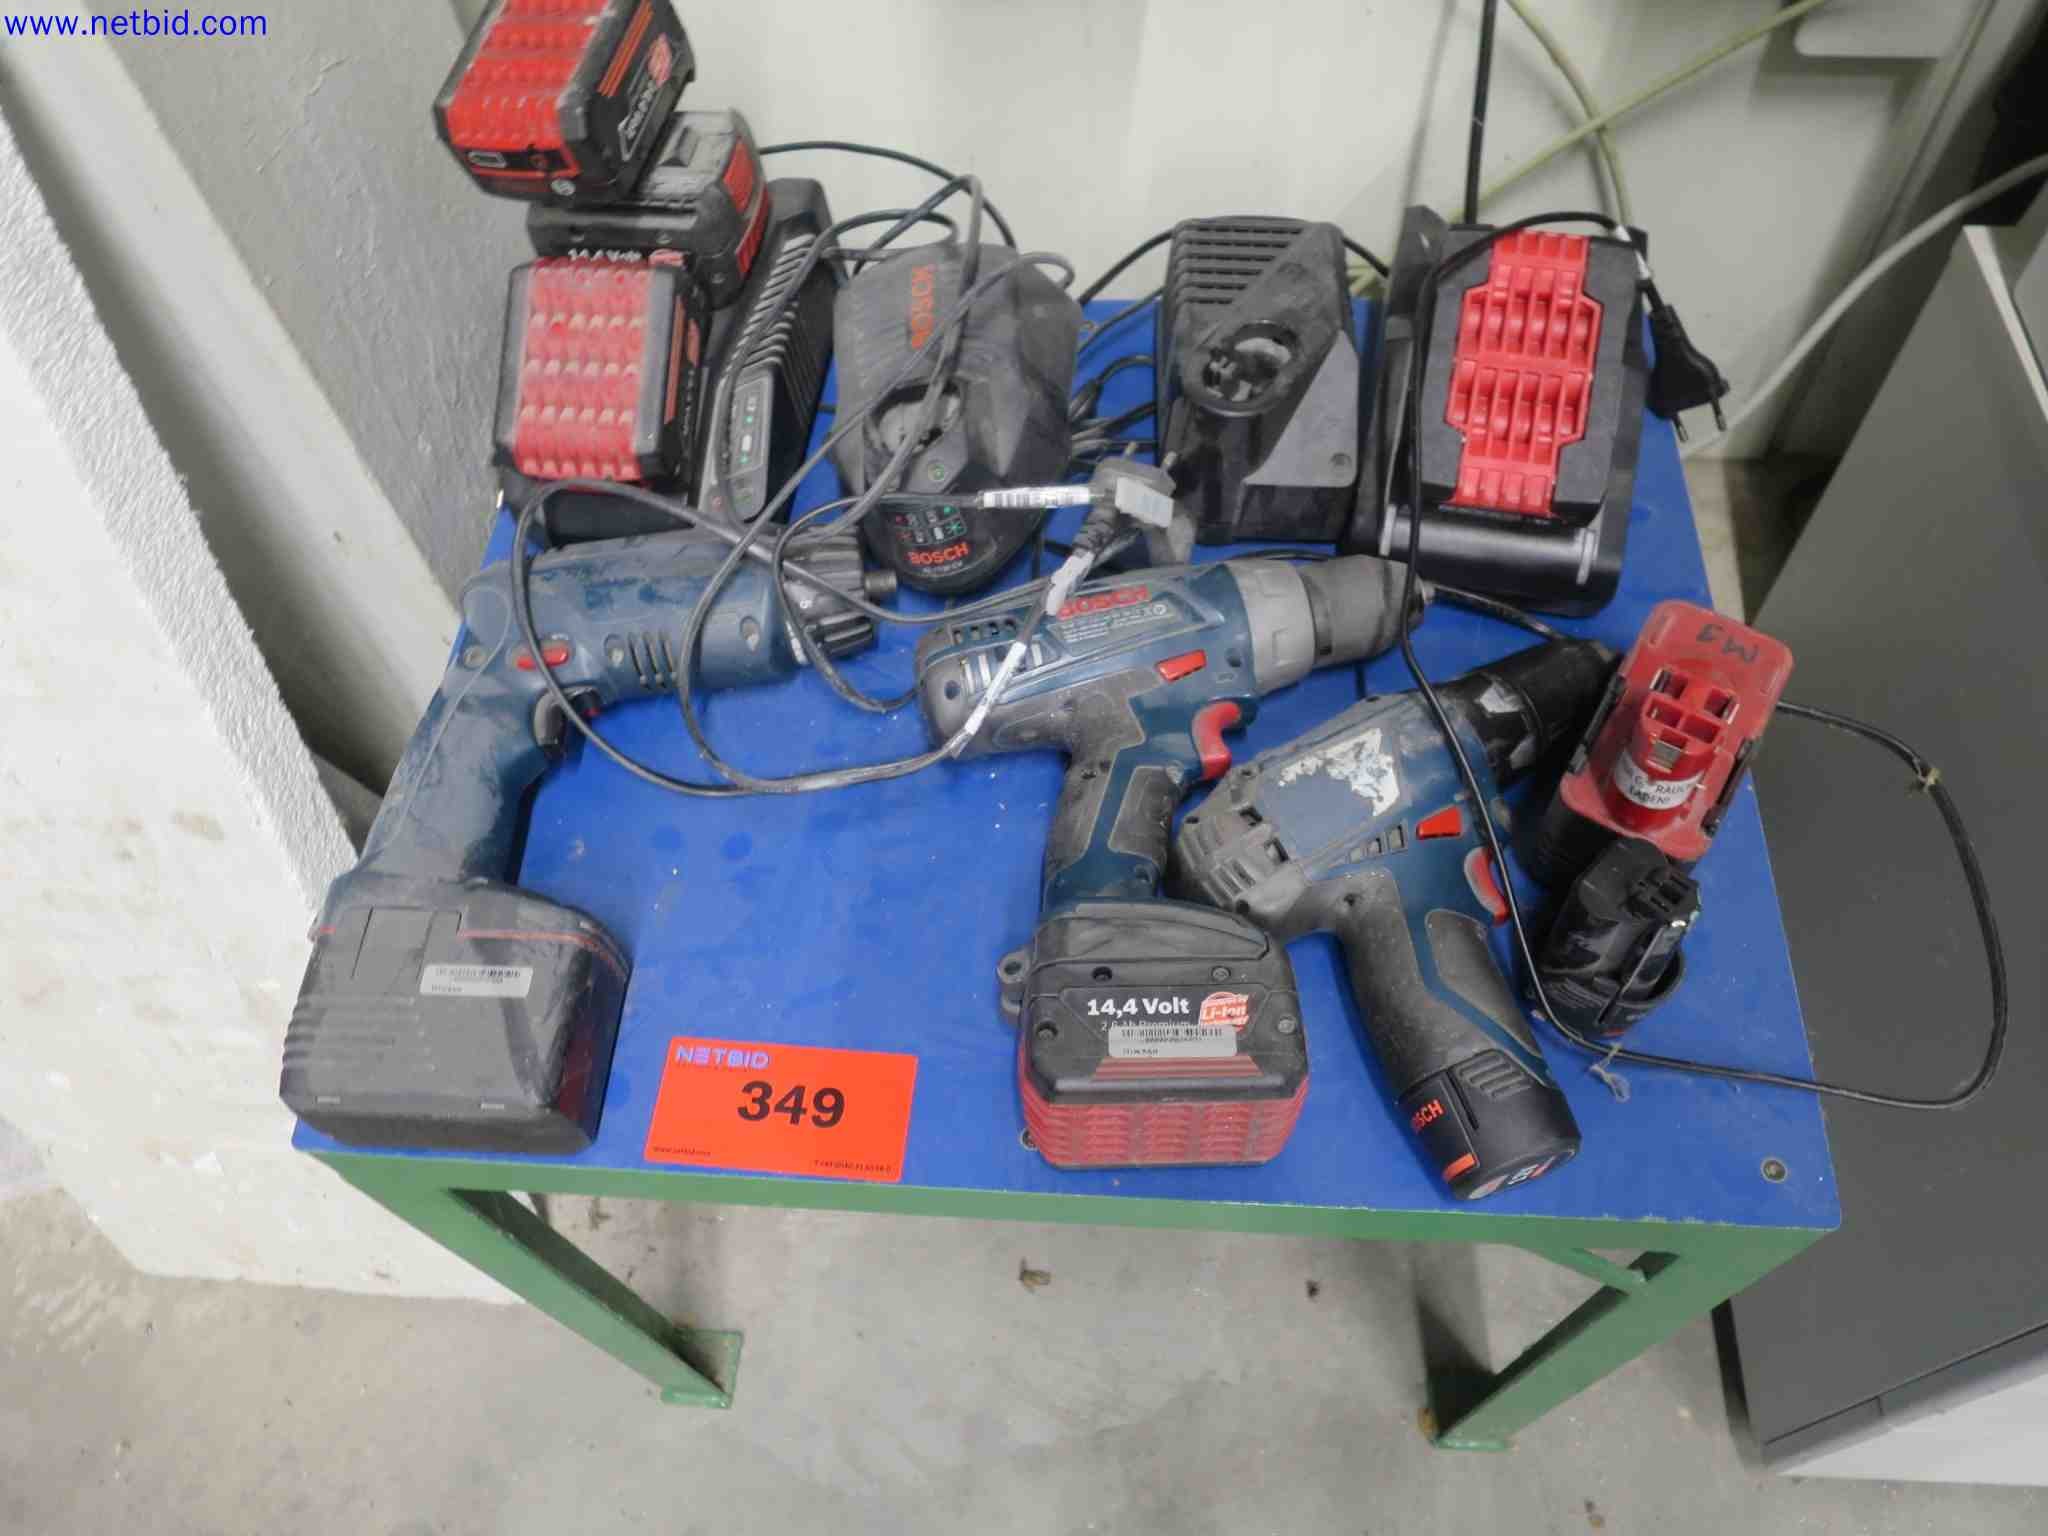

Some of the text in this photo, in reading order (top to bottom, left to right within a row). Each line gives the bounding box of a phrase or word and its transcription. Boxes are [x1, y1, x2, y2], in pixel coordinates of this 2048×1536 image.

[907, 541, 970, 566] BOSCH
[1057, 584, 1152, 620] BOSCH
[1087, 997, 1138, 1018] 14,4
[1142, 996, 1190, 1014] Volt
[675, 1044, 771, 1070] NETBID
[737, 1080, 846, 1129] 349
